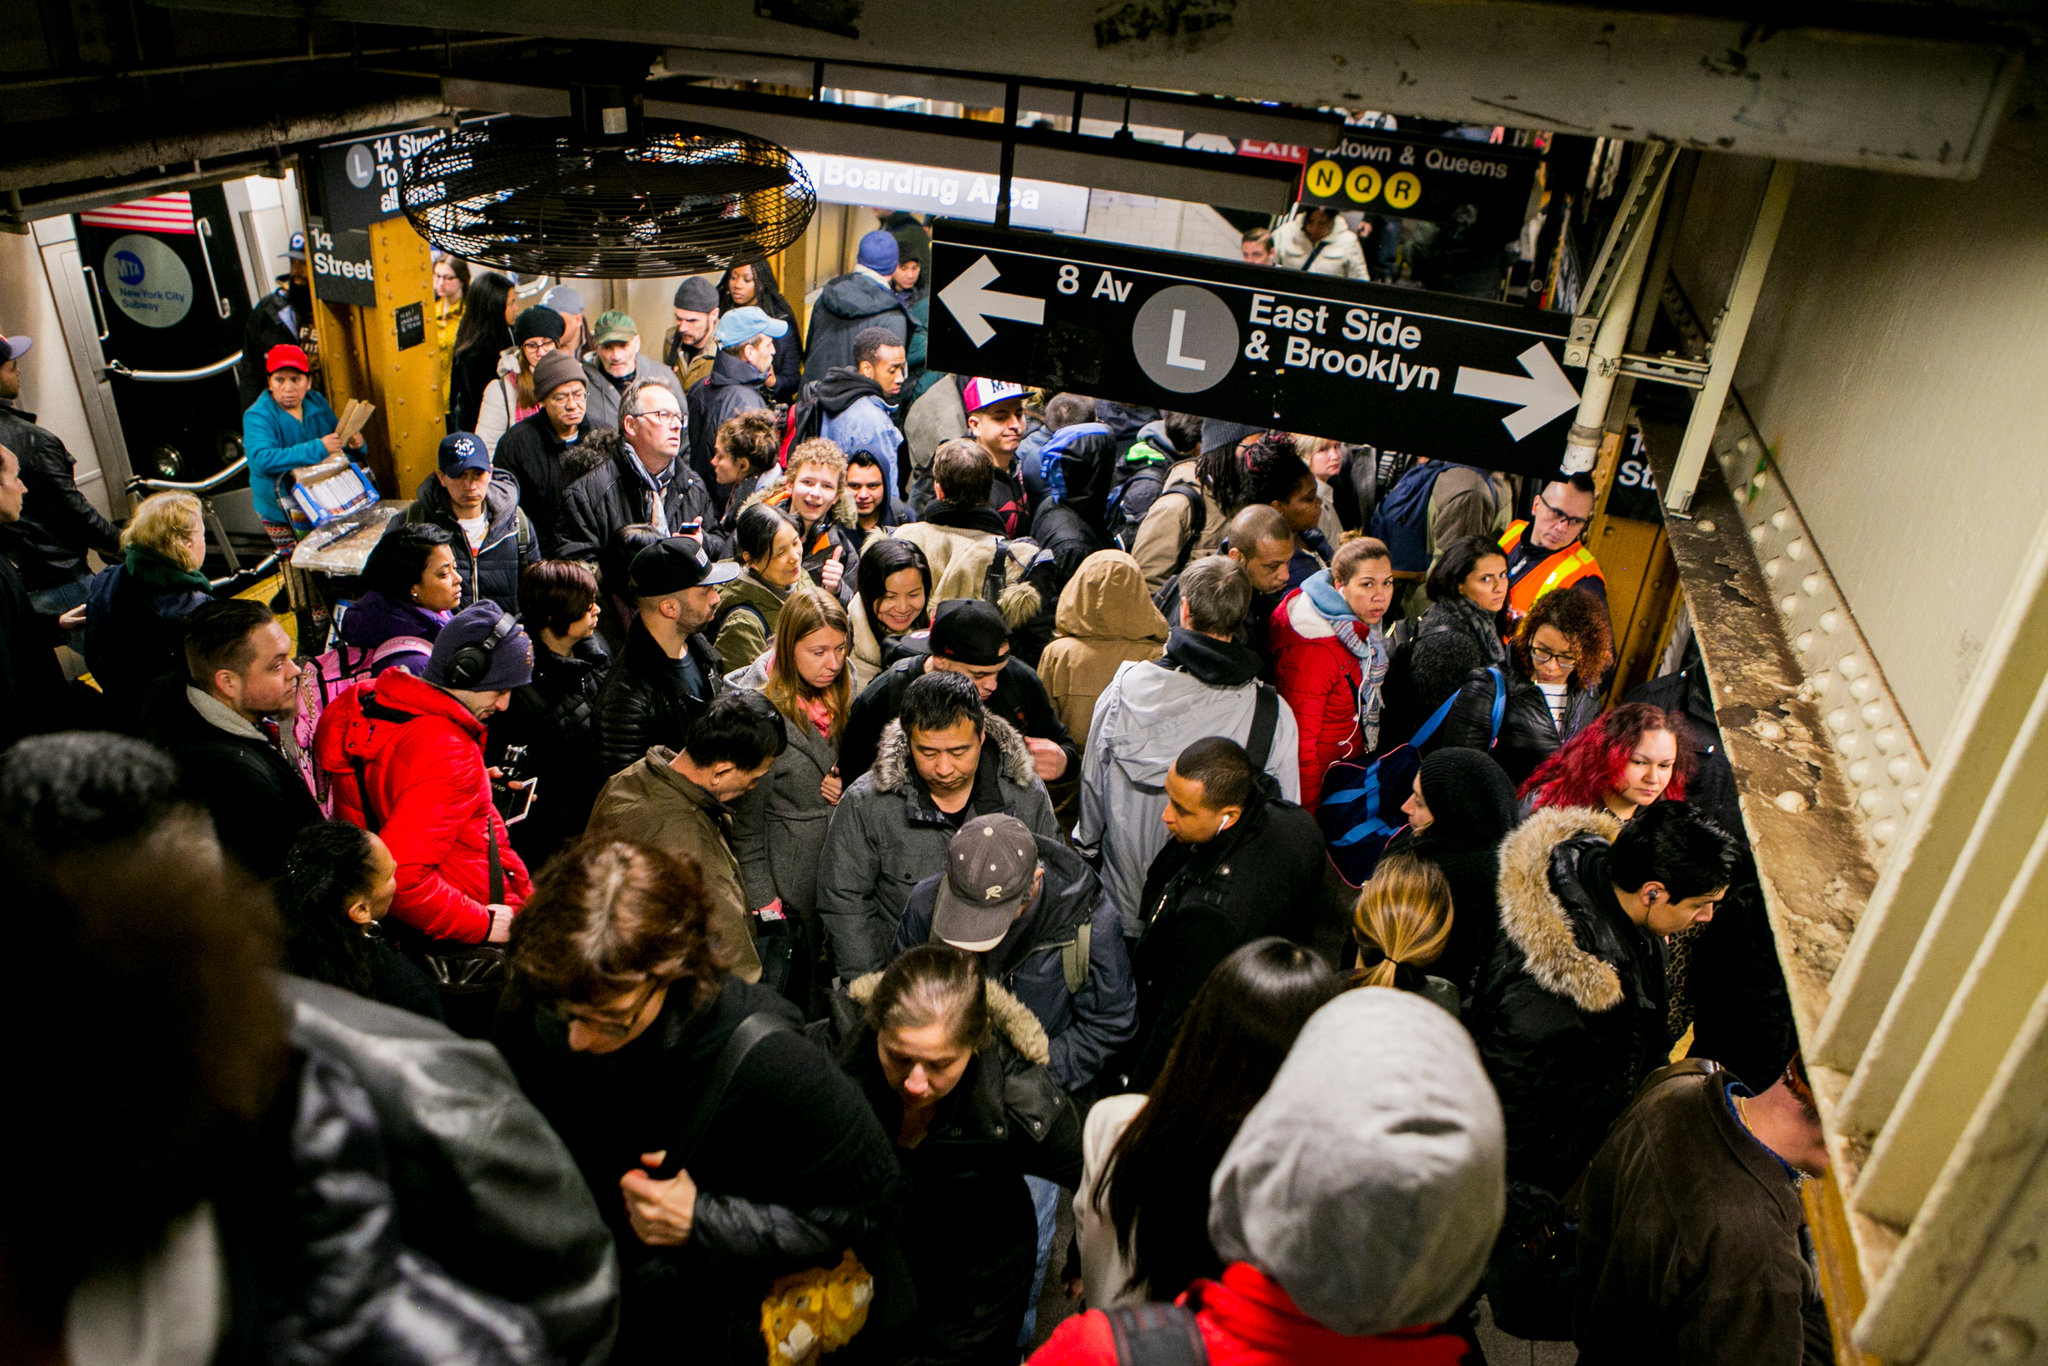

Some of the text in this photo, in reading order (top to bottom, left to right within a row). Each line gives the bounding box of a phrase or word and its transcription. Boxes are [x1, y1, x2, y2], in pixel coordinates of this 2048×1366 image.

[373, 138, 395, 163] 14
[1313, 137, 1508, 179] town & Queens
[353, 153, 369, 179] L
[376, 163, 399, 188] To
[823, 159, 961, 207] Boarding
[1316, 167, 1412, 200] N Q R
[380, 186, 400, 213] all
[310, 227, 334, 251] 14
[313, 252, 375, 282] Street
[119, 287, 185, 304] New York City
[1056, 263, 1134, 303] 8 Av
[121, 299, 159, 313] Subway
[1249, 292, 1422, 350] East Side
[1165, 308, 1207, 372] L
[1244, 329, 1441, 392] & Brooklyn
[1630, 432, 1646, 456] 1
